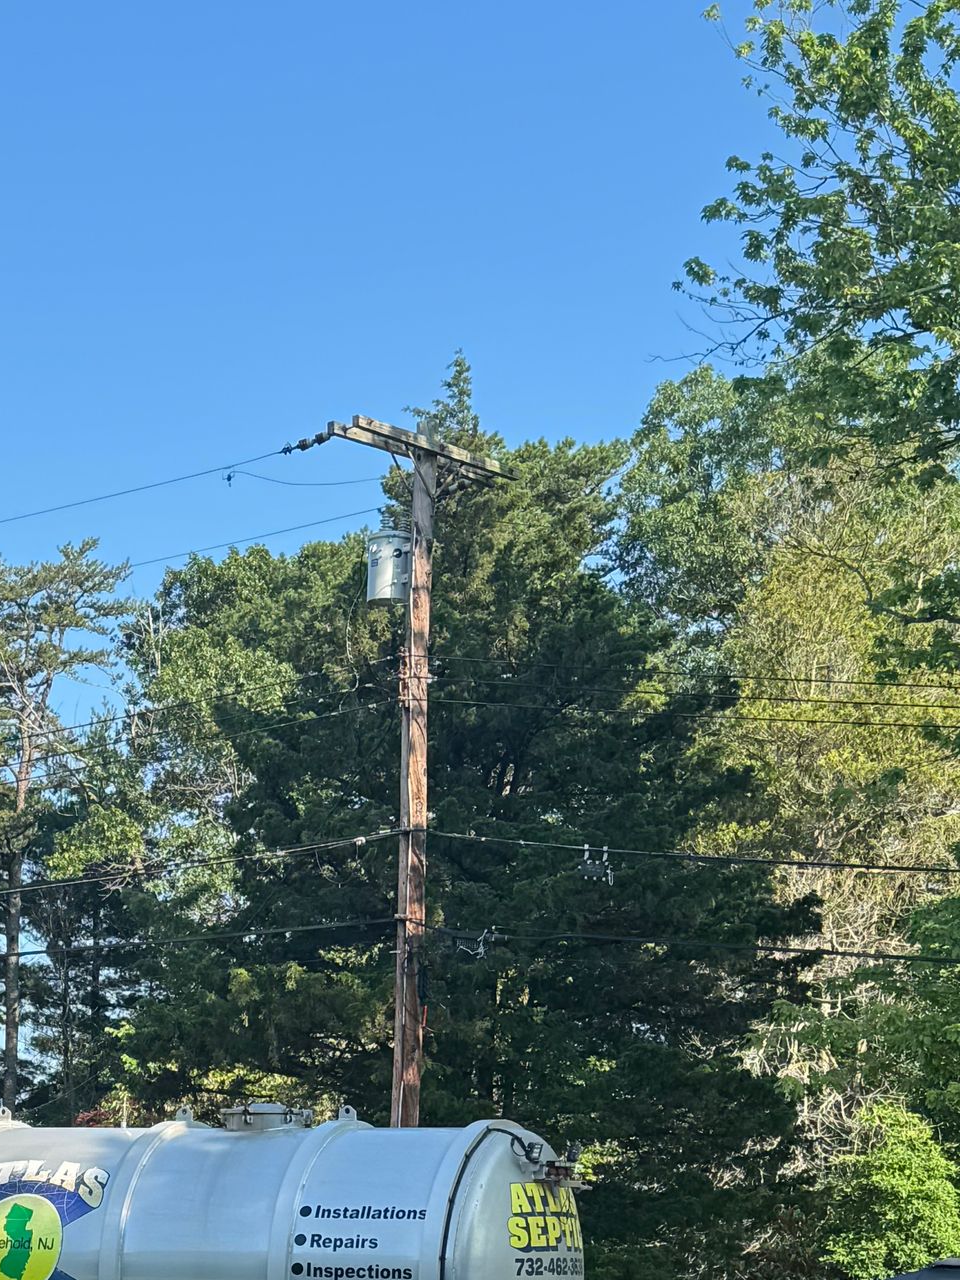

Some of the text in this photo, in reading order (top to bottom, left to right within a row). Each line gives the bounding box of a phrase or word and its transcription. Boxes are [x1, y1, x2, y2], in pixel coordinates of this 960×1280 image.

[315, 1205, 427, 1220] Installations
[38, 1237, 54, 1250] NJ
[310, 1233, 378, 1252] Repairs
[306, 1262, 412, 1280] Inspections
